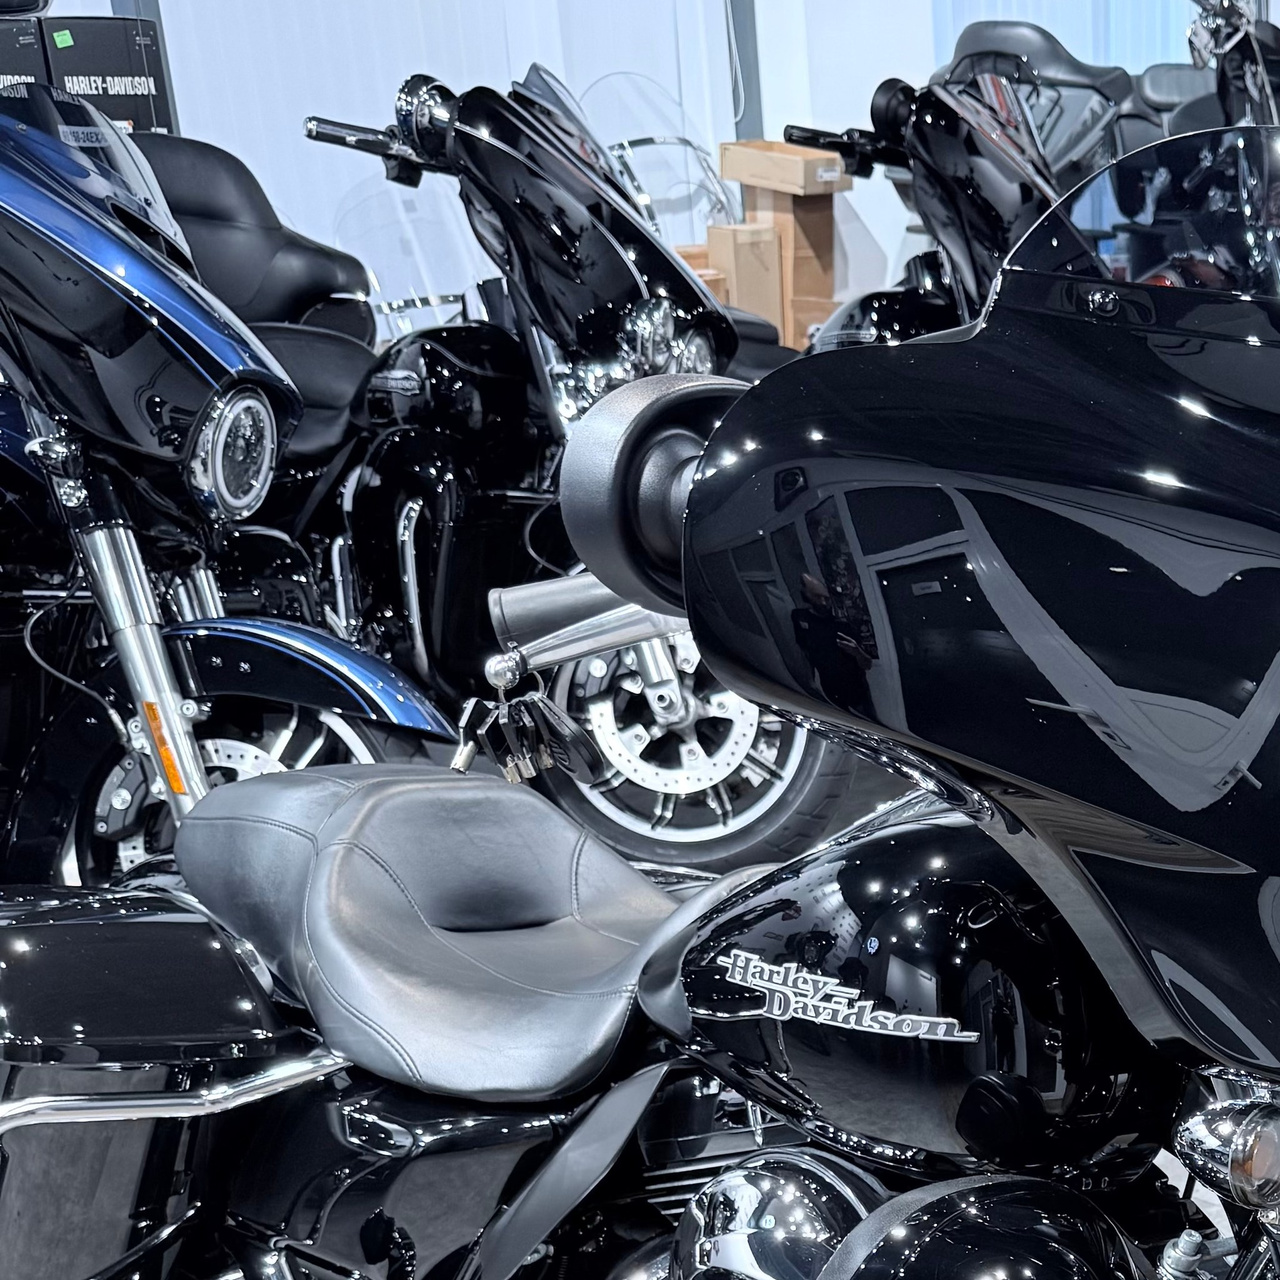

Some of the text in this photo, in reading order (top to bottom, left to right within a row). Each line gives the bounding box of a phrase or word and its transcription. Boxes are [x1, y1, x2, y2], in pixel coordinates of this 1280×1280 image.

[64, 75, 156, 96] HARLEY-DAVIDSON
[718, 948, 860, 1000] Harley
[763, 983, 981, 1044] Davidson
